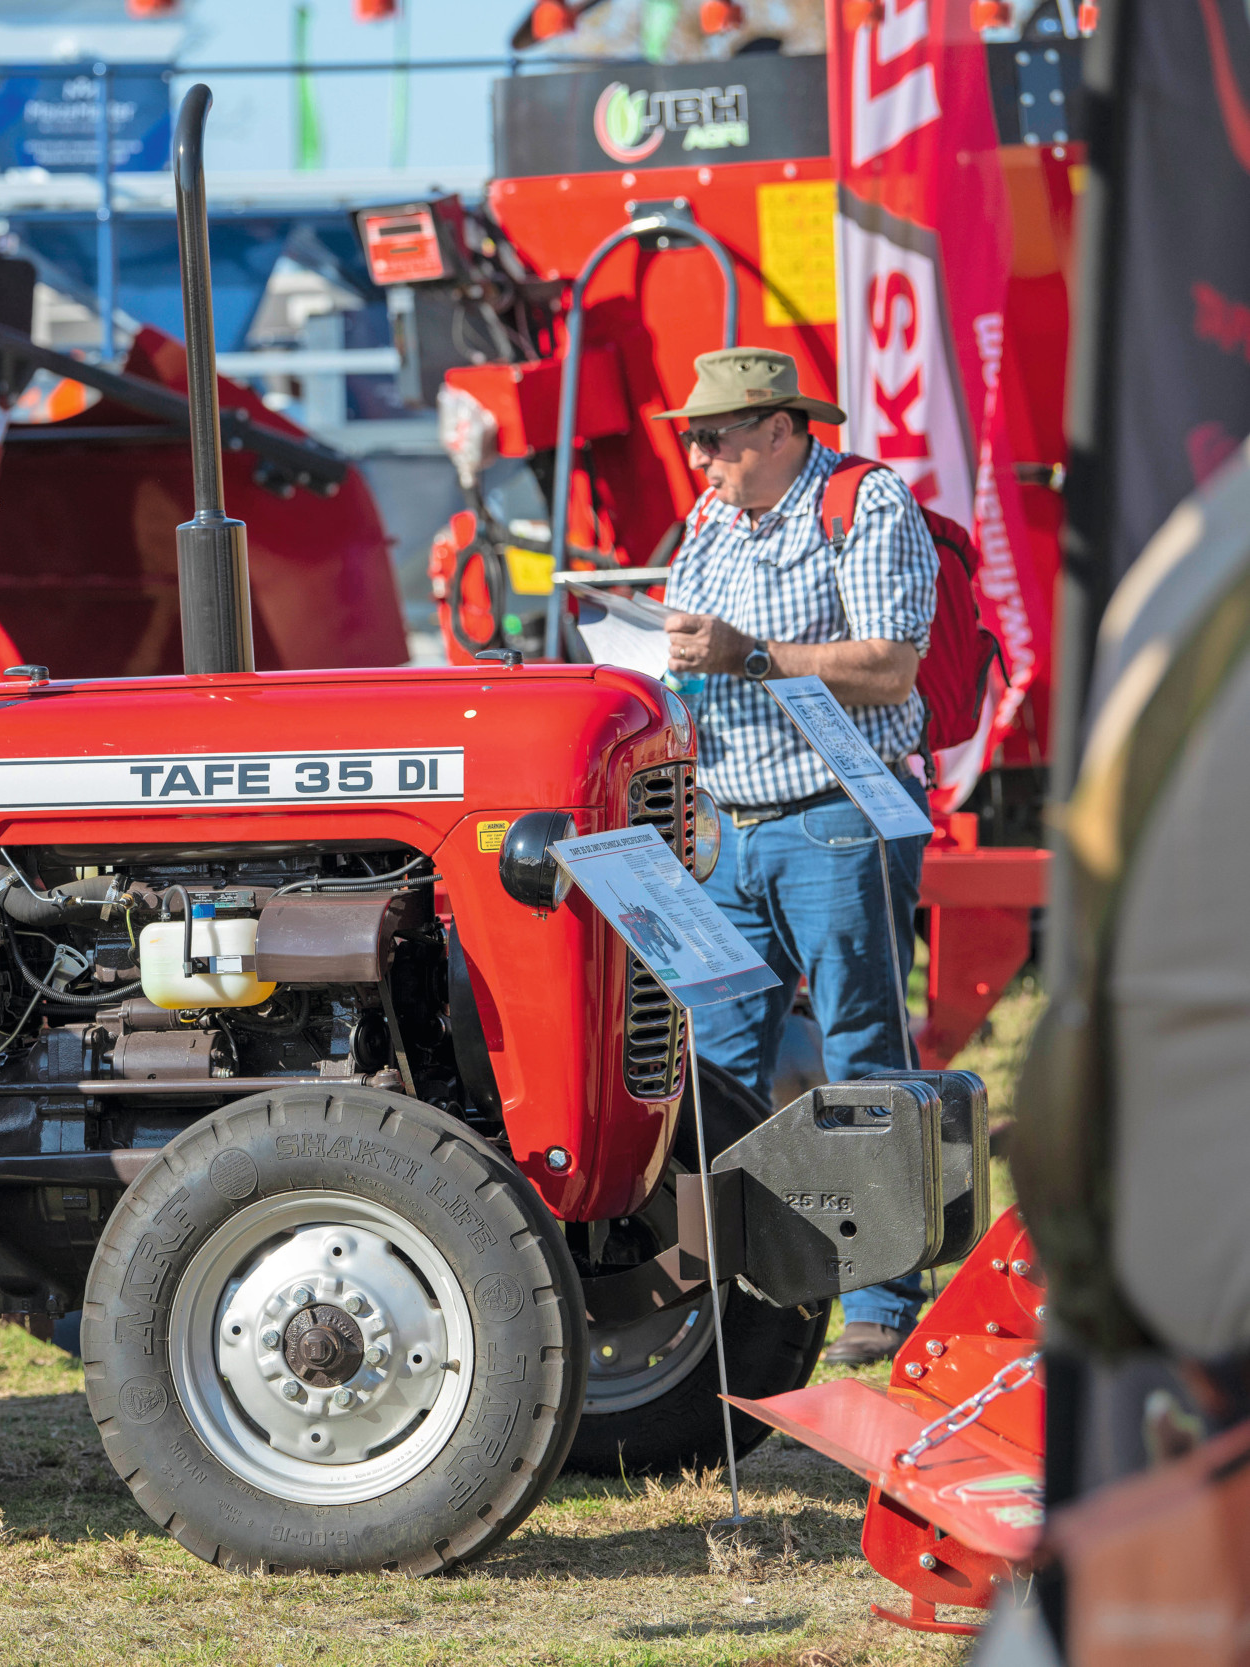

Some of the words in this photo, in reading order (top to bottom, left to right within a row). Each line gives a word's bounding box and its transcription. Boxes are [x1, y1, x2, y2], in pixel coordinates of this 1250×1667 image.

[642, 85, 748, 131] JBH
[130, 761, 271, 797] TAFE
[294, 760, 374, 795] 35
[398, 759, 440, 791] DI
[275, 1133, 423, 1186] SHAKTI
[426, 1176, 498, 1254] LIFE
[786, 1193, 814, 1210] 25
[820, 1193, 851, 1212] Kg
[119, 1187, 193, 1356] MRF
[444, 1340, 527, 1511] MRF
[168, 1441, 207, 1484] NYLON
[270, 1525, 349, 1547] 6.00-16
